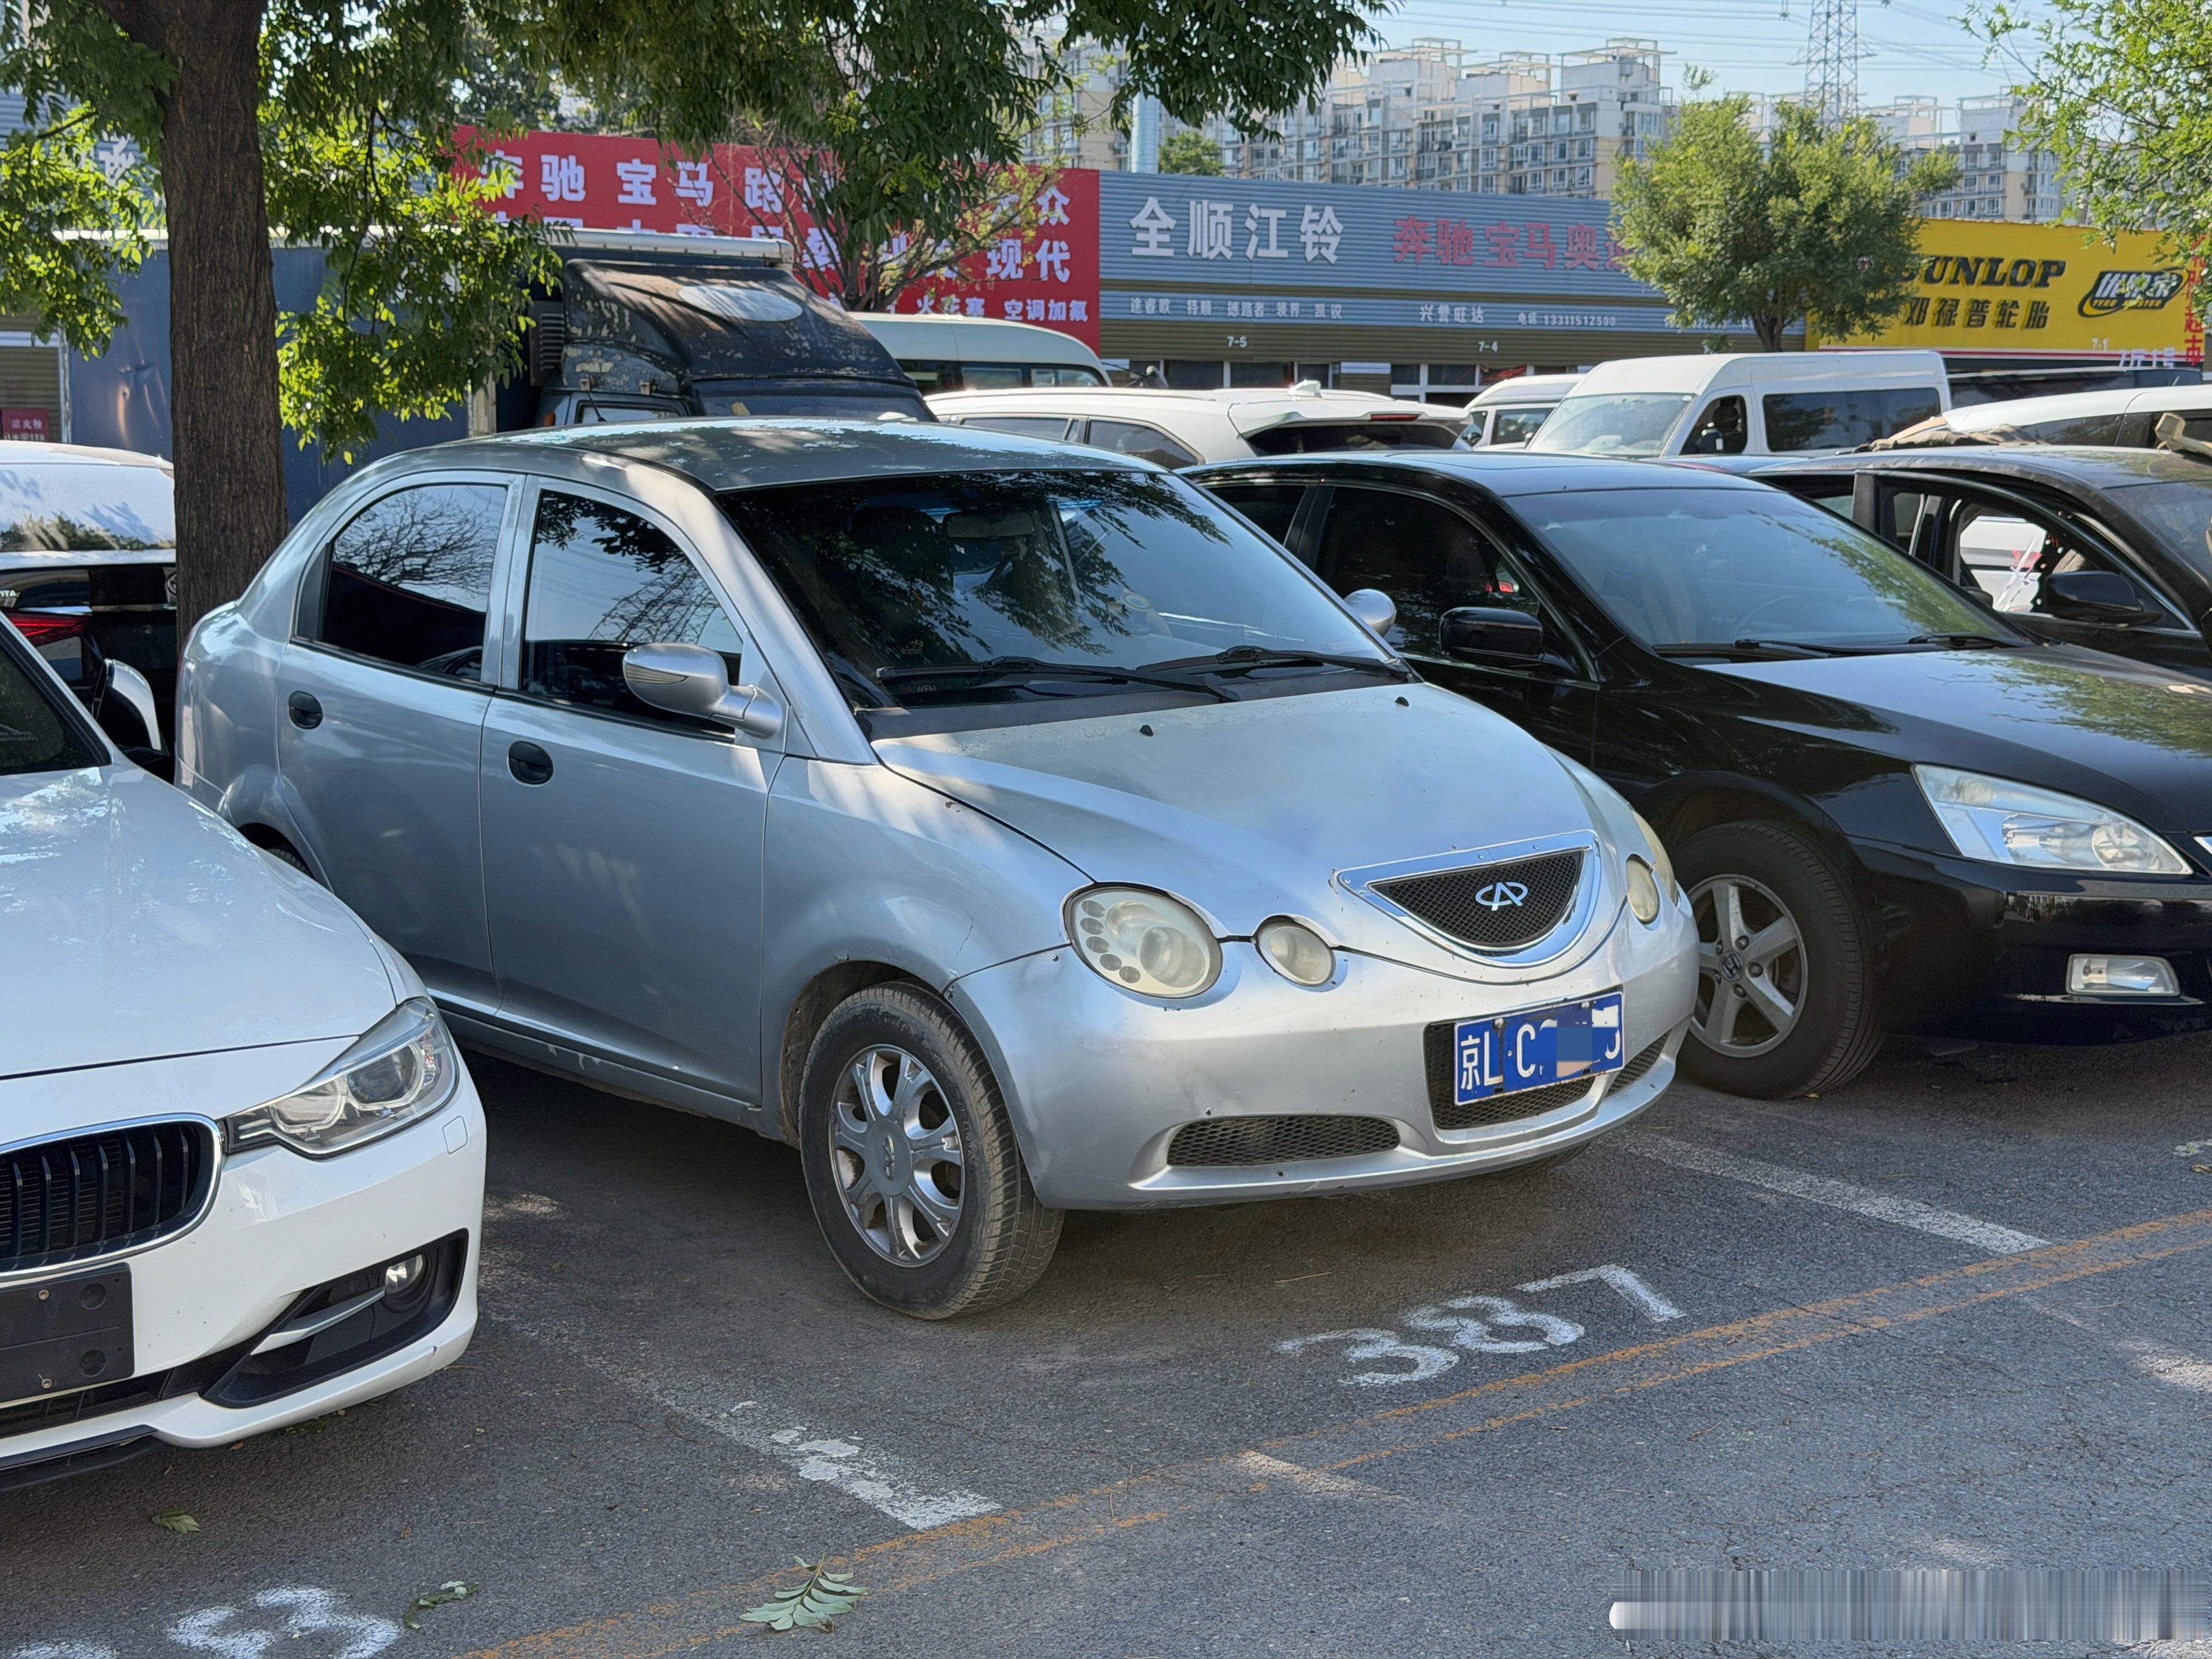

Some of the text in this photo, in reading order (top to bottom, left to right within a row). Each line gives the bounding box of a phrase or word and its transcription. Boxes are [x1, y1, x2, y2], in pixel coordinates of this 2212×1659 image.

[1129, 196, 1344, 264] 全顺江铃
[986, 237, 1071, 283] 现代
[1898, 255, 2066, 288] UNLOP
[1004, 298, 1089, 321] 空调加氟
[1904, 296, 2051, 330] 邓禄普轮胎
[1227, 336, 1248, 348] 7-5
[1478, 341, 1498, 352] 7-4
